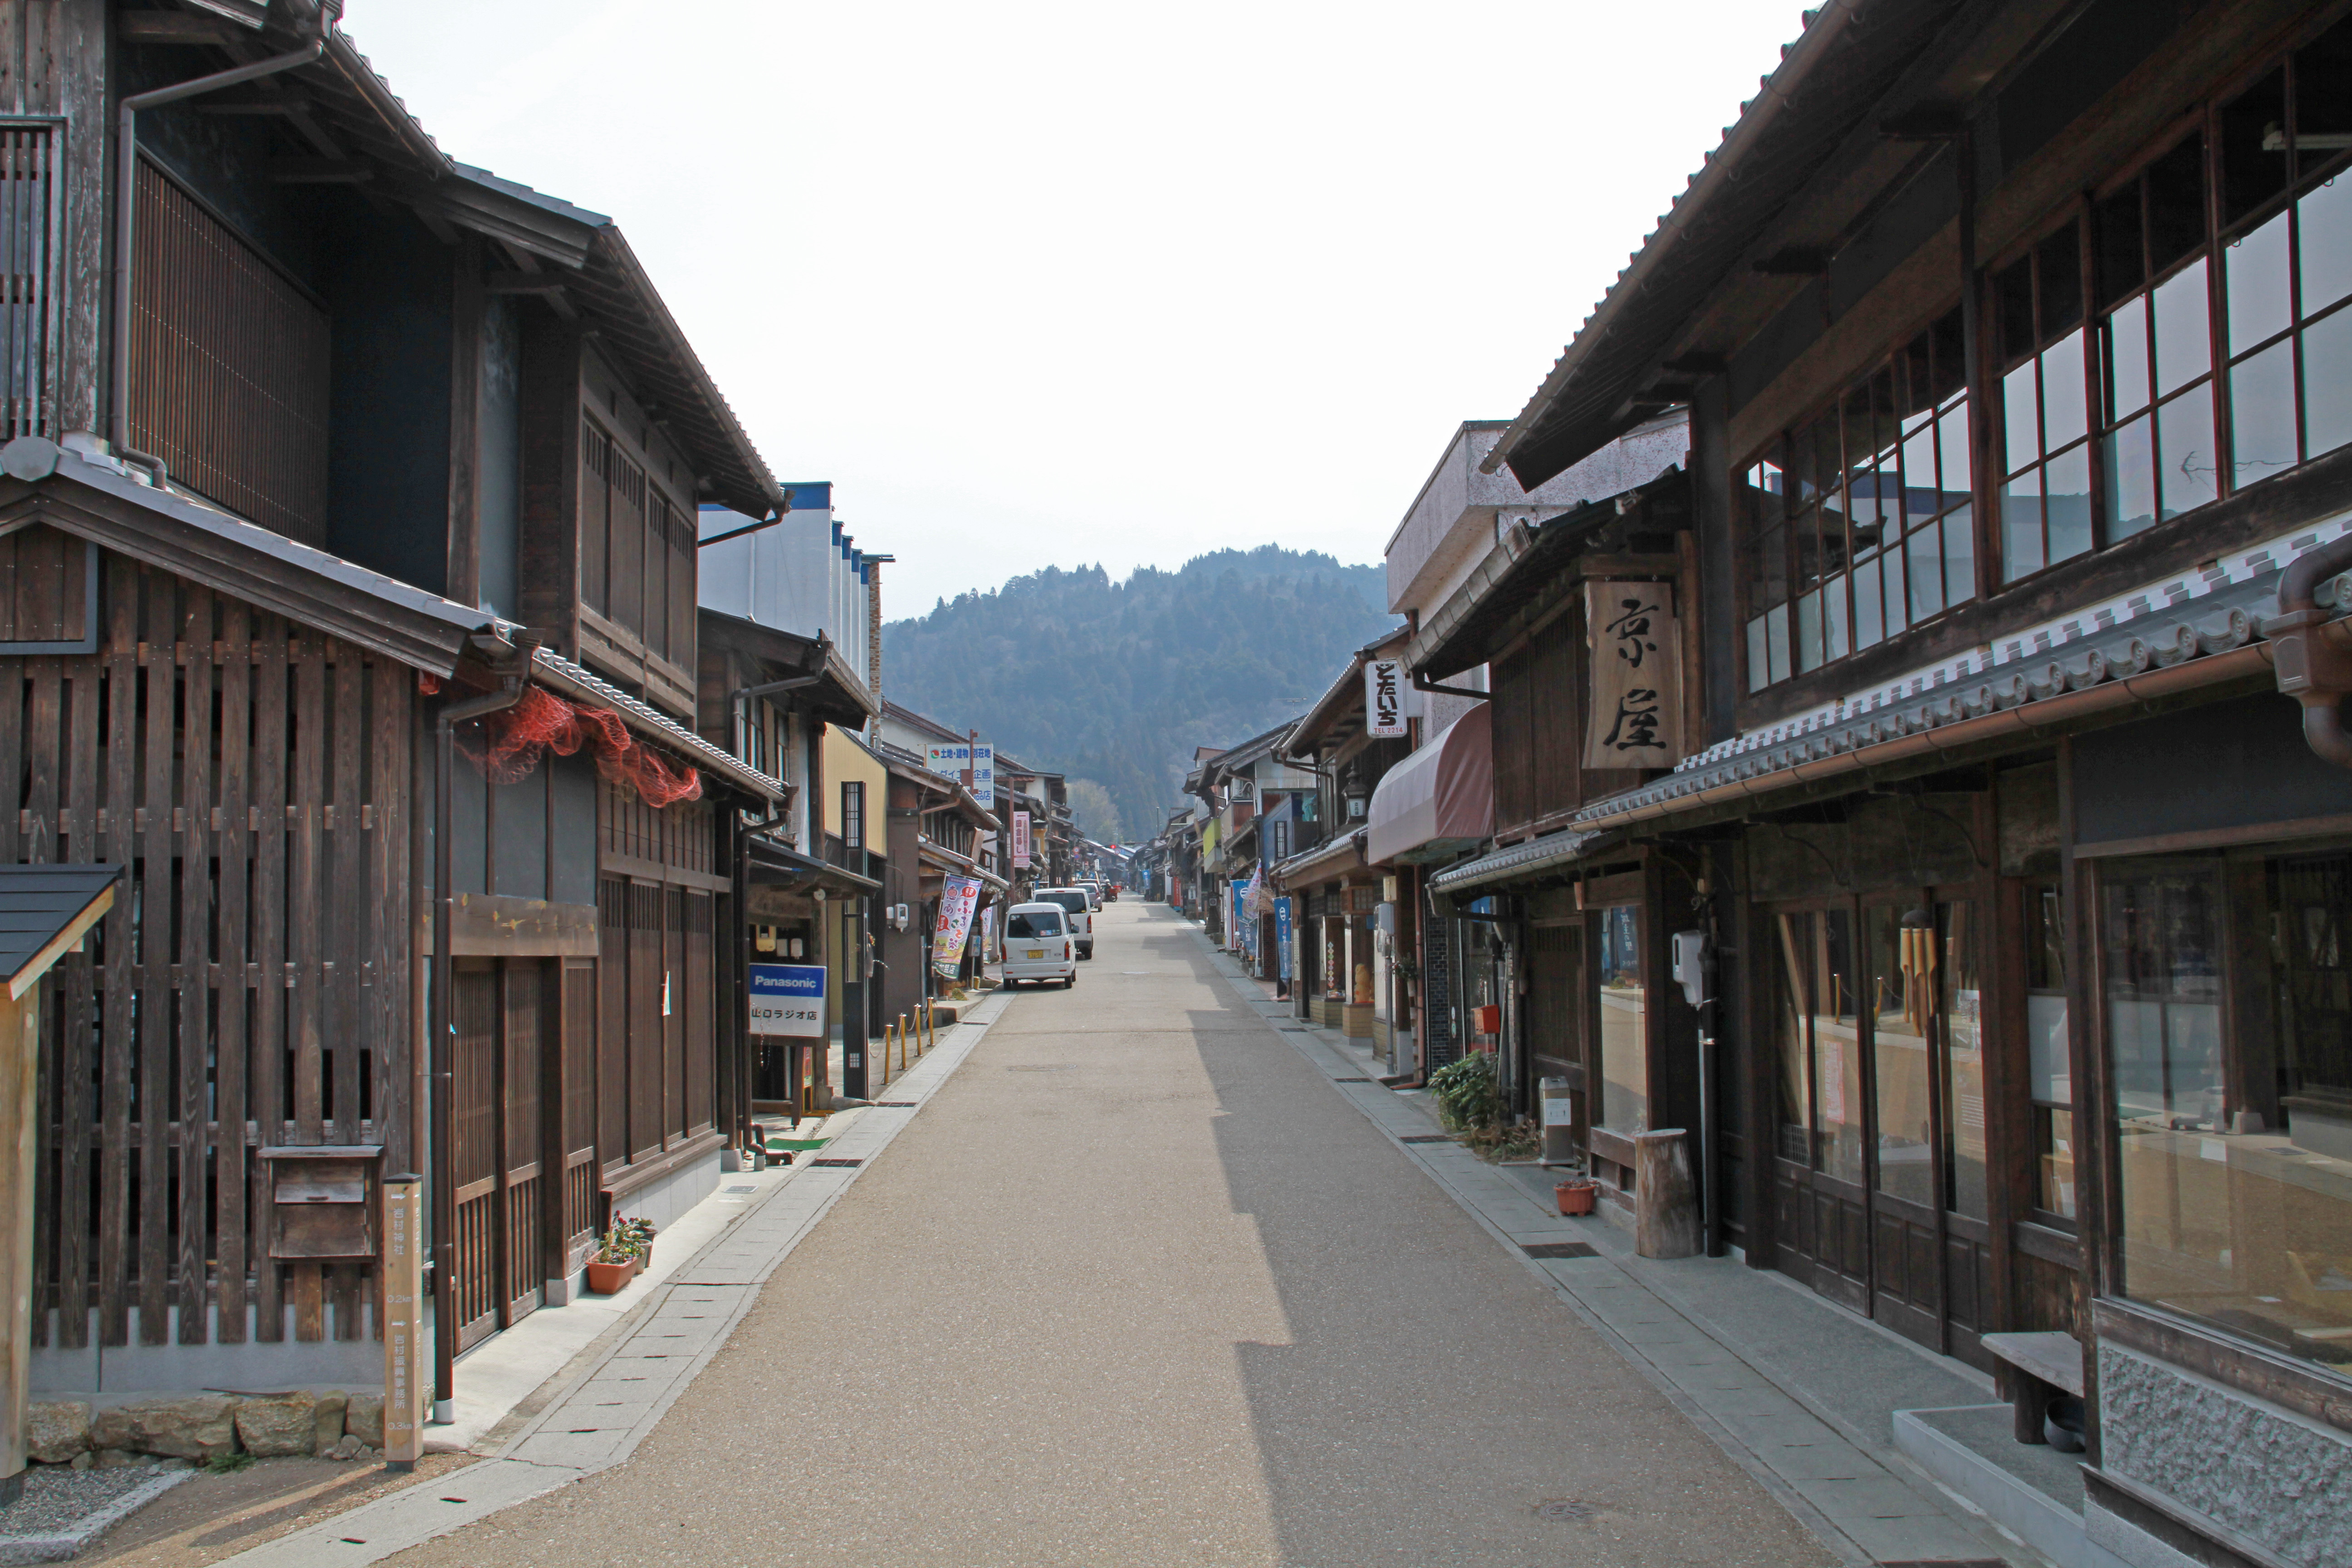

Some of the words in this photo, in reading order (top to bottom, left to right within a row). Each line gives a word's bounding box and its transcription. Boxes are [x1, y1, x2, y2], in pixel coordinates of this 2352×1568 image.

[1603, 599, 1666, 750] 京屋
[755, 975, 817, 988] Panasonic
[752, 1008, 817, 1020] 山口ラジオ店
[393, 1207, 404, 1255] 岩村神社
[387, 1294, 412, 1303] 0.2km
[394, 1335, 405, 1409] 岩村振興事務所
[387, 1421, 412, 1430] 0.3km
